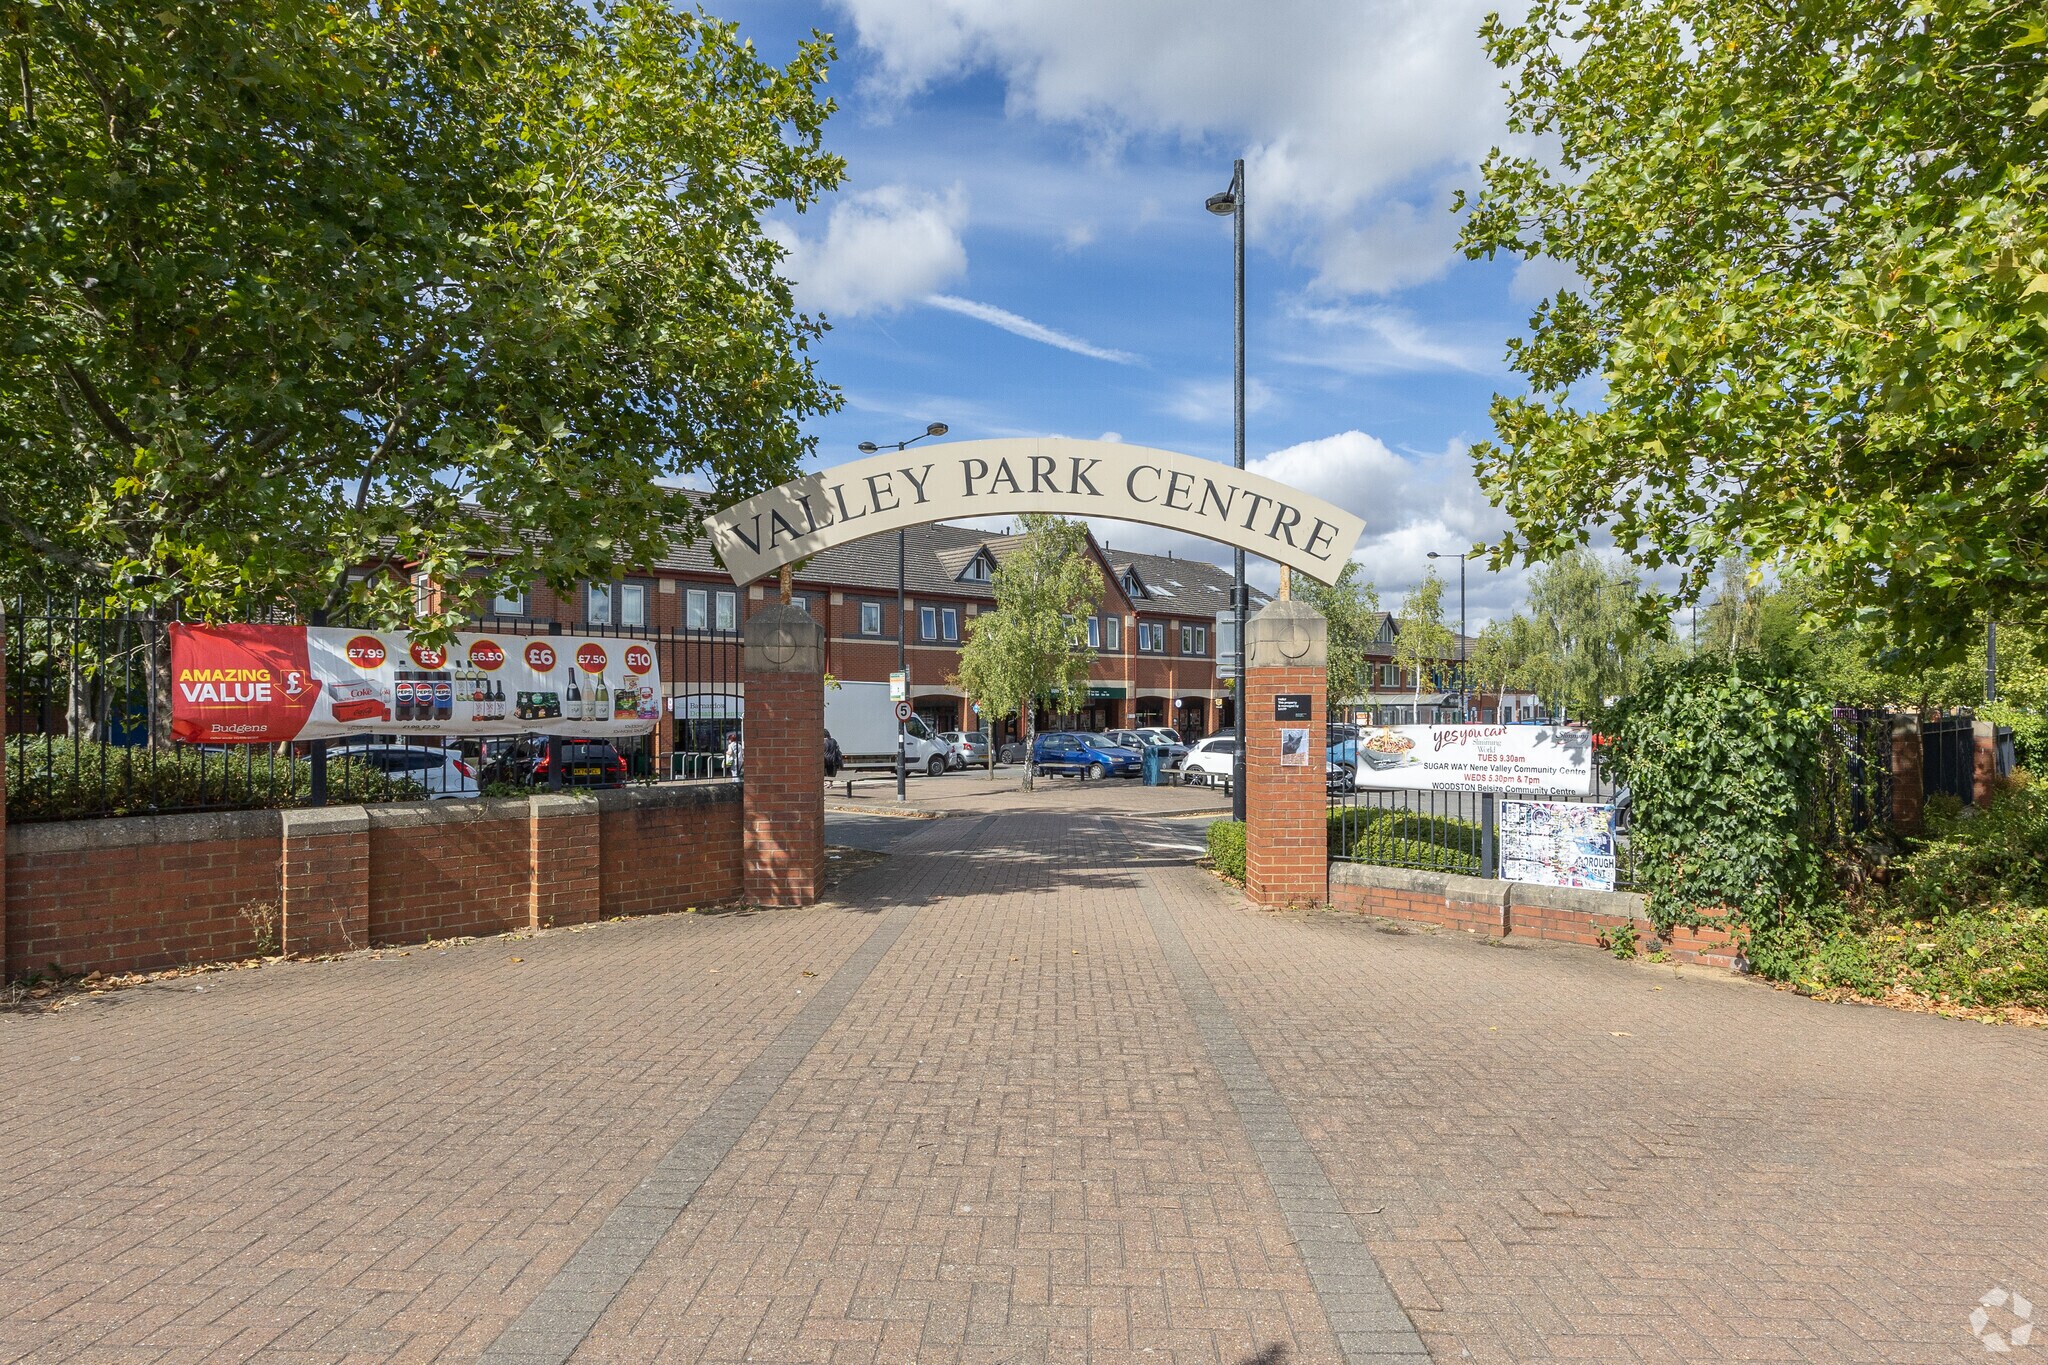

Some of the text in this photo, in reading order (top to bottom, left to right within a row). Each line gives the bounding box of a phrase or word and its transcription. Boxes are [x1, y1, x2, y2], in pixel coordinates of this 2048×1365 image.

[728, 456, 1340, 562] VALLEY PARK CENTRE
[348, 648, 384, 658] £7.99
[420, 651, 439, 664] £3
[471, 652, 503, 661] £6.50
[529, 649, 553, 665] £6
[578, 655, 606, 664] £7.50
[627, 653, 651, 666] £10
[180, 669, 270, 682] AMAZING
[286, 672, 302, 694] £
[180, 683, 272, 702] VALUE
[351, 688, 372, 698] Coke
[900, 706, 907, 716] 5
[211, 724, 268, 733] Budgens
[1434, 728, 1507, 752] yes you can
[1490, 765, 1512, 774] Valley
[1514, 765, 1557, 775] Community
[1560, 767, 1586, 775] Centre
[1488, 775, 1514, 783] 5.30pm
[1524, 776, 1540, 785] 7pm
[1432, 782, 1476, 790] WOODSTON
[1505, 785, 1548, 795] Community
[1550, 787, 1576, 795] Centre
